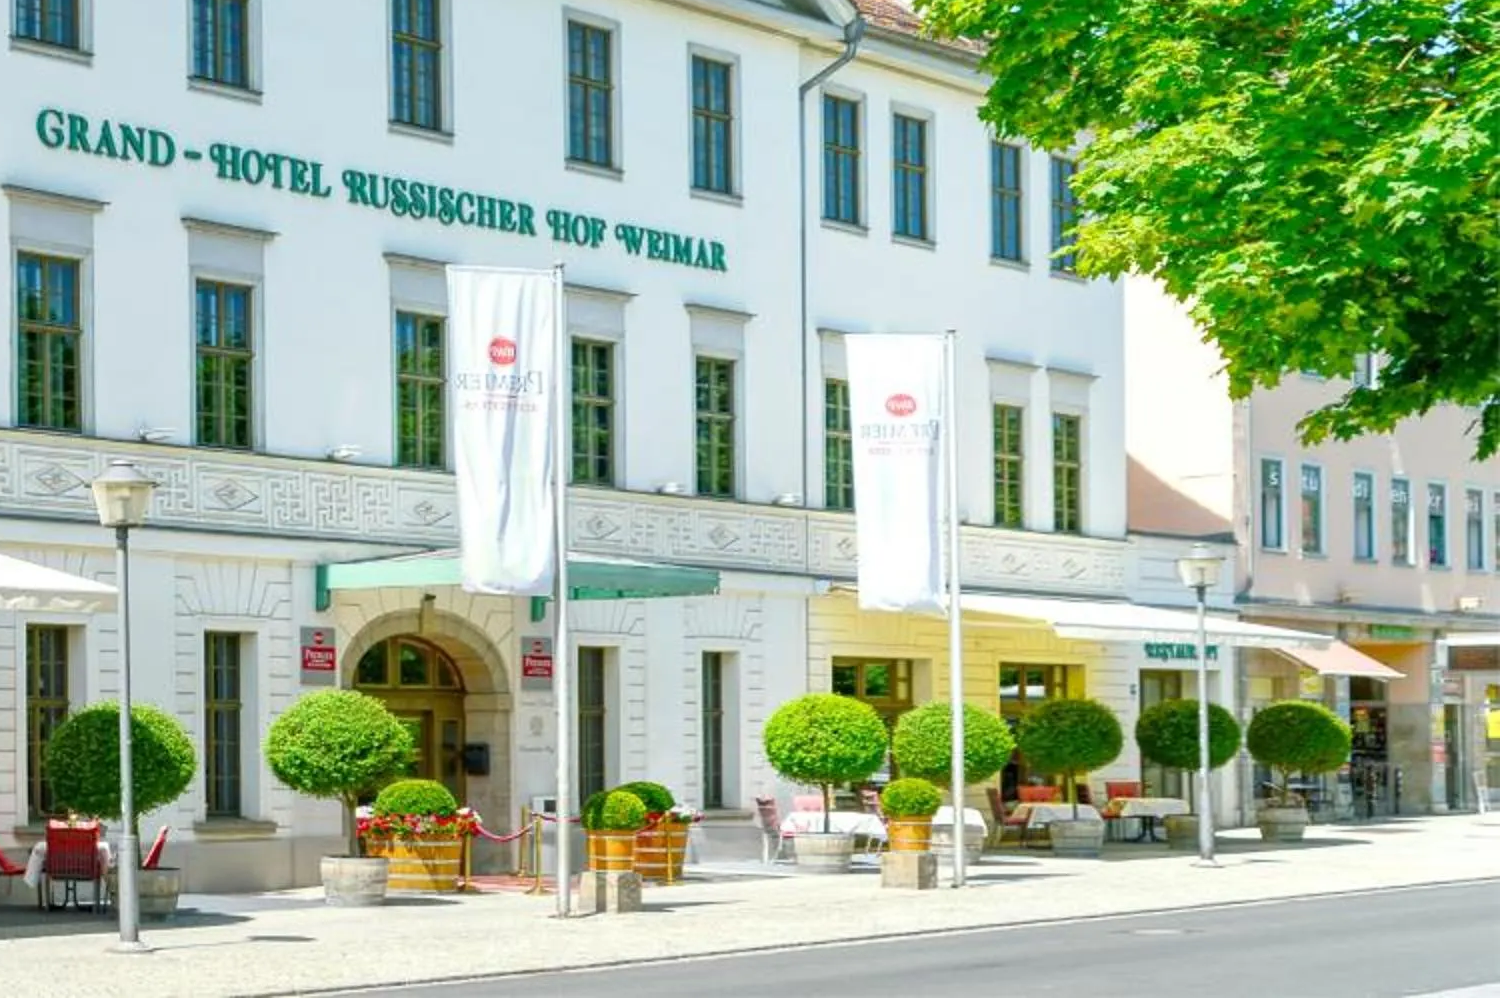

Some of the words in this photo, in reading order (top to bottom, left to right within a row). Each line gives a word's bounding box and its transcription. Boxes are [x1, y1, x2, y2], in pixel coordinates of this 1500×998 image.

[341, 168, 538, 237] RUSSISCHER
[546, 208, 608, 249] HOF
[614, 222, 730, 272] WEIMAR
